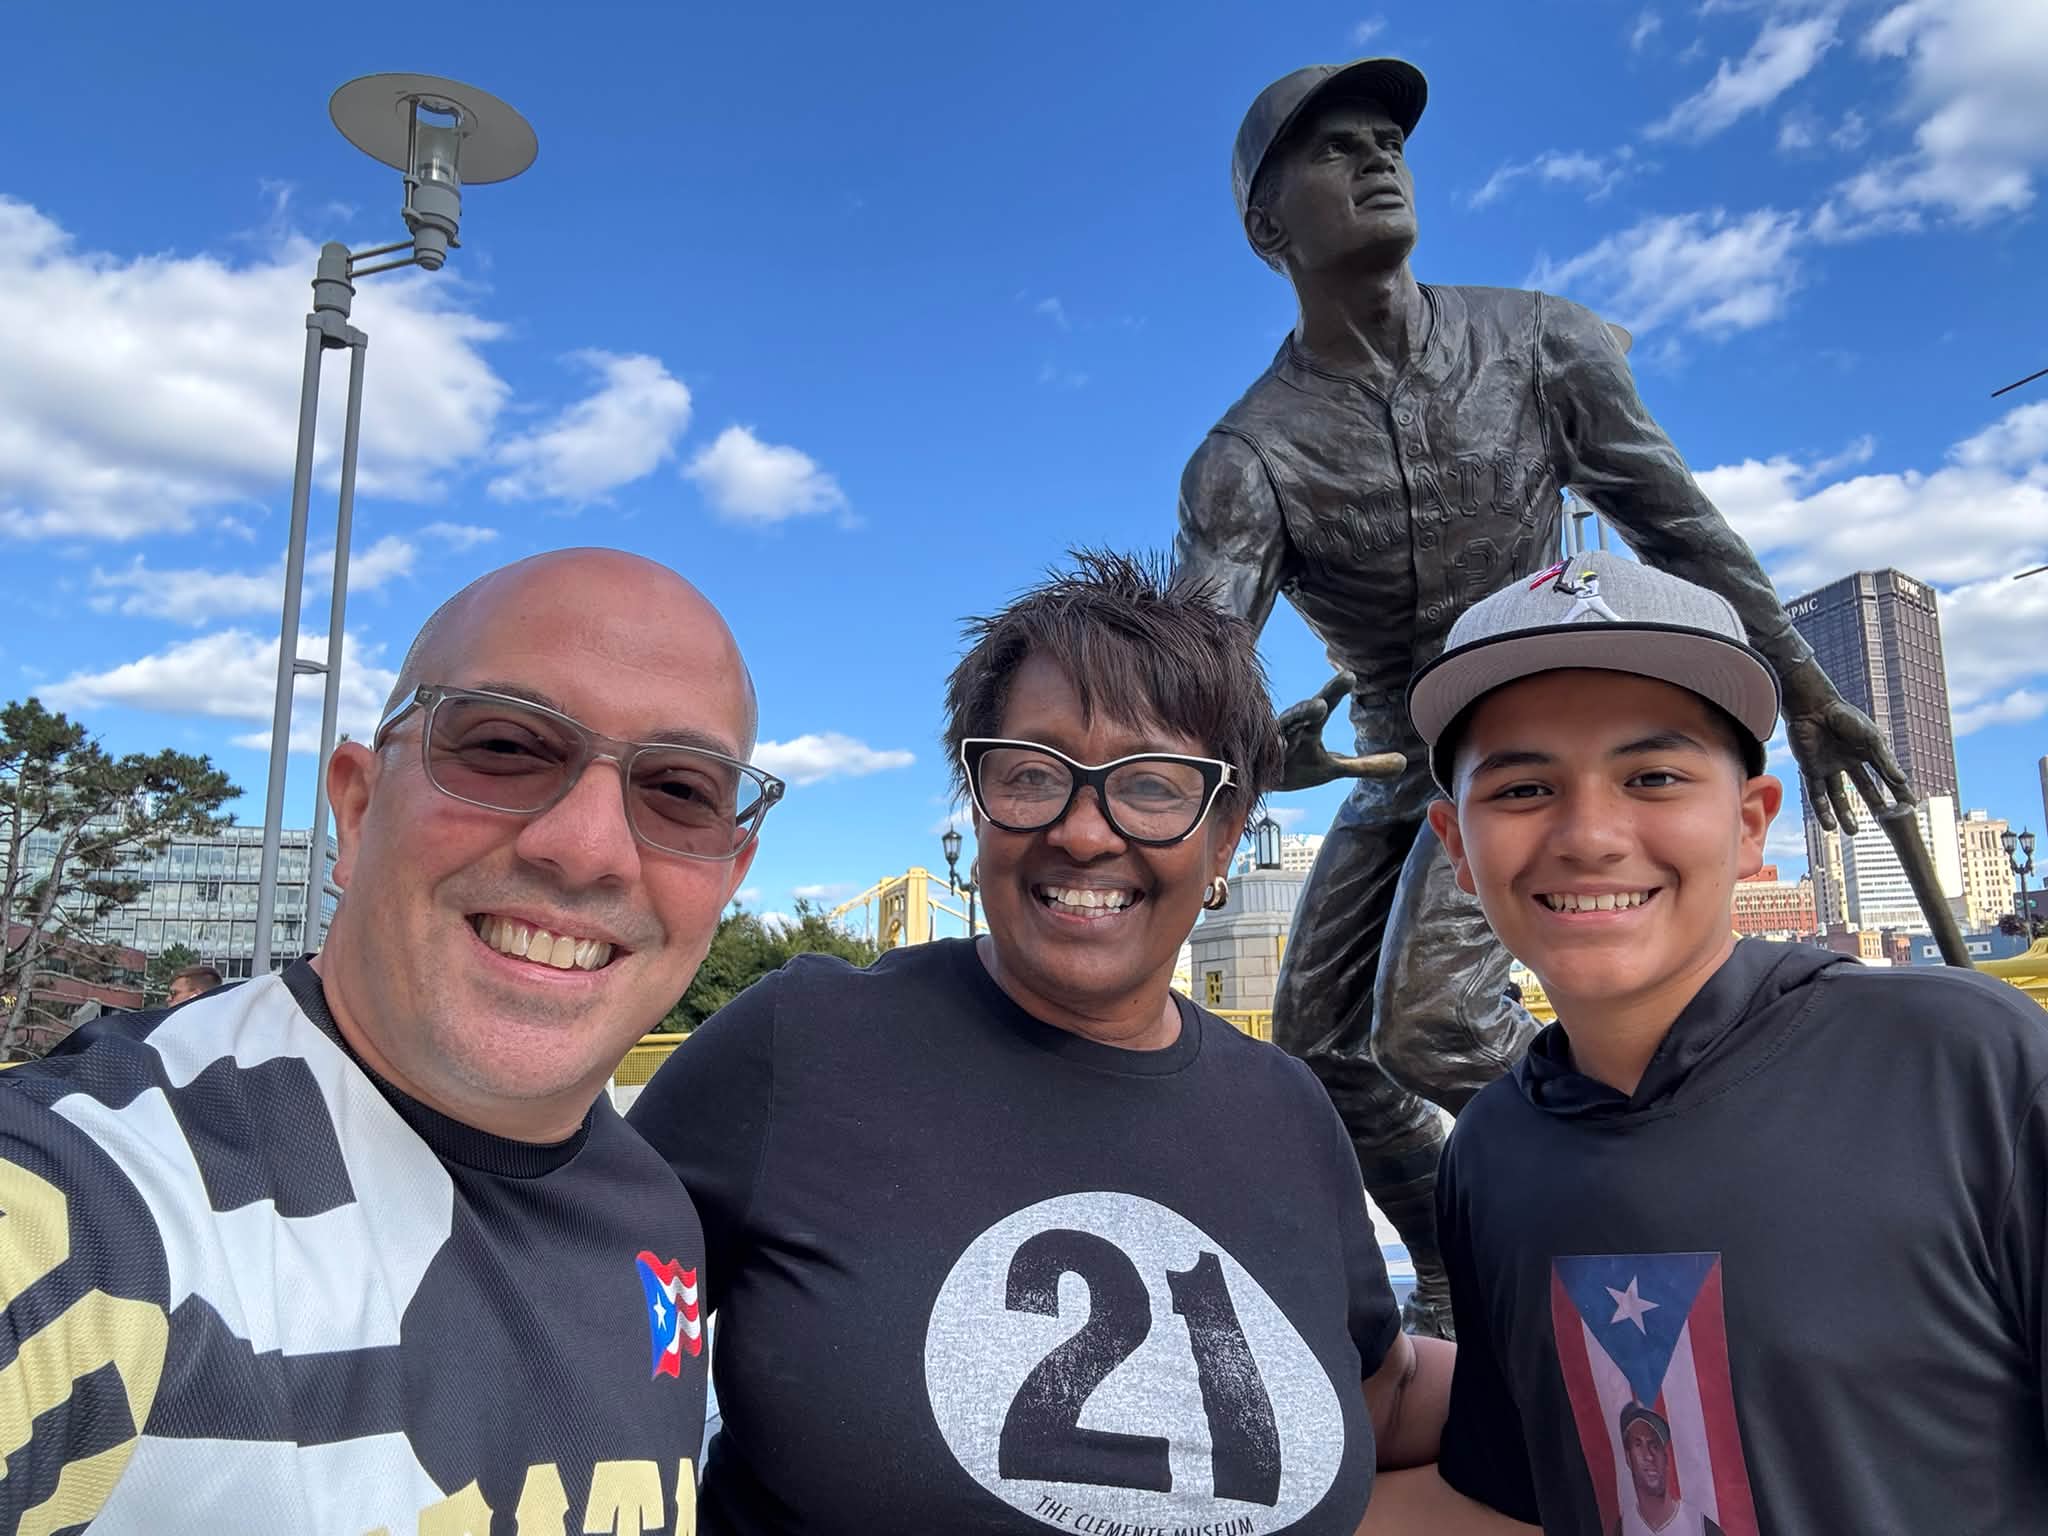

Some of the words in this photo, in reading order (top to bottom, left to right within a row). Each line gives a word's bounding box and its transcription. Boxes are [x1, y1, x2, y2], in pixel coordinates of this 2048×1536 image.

[1897, 576, 1921, 598] UPMC
[1000, 1228, 1281, 1507] 21
[1034, 1495, 1073, 1524] THE
